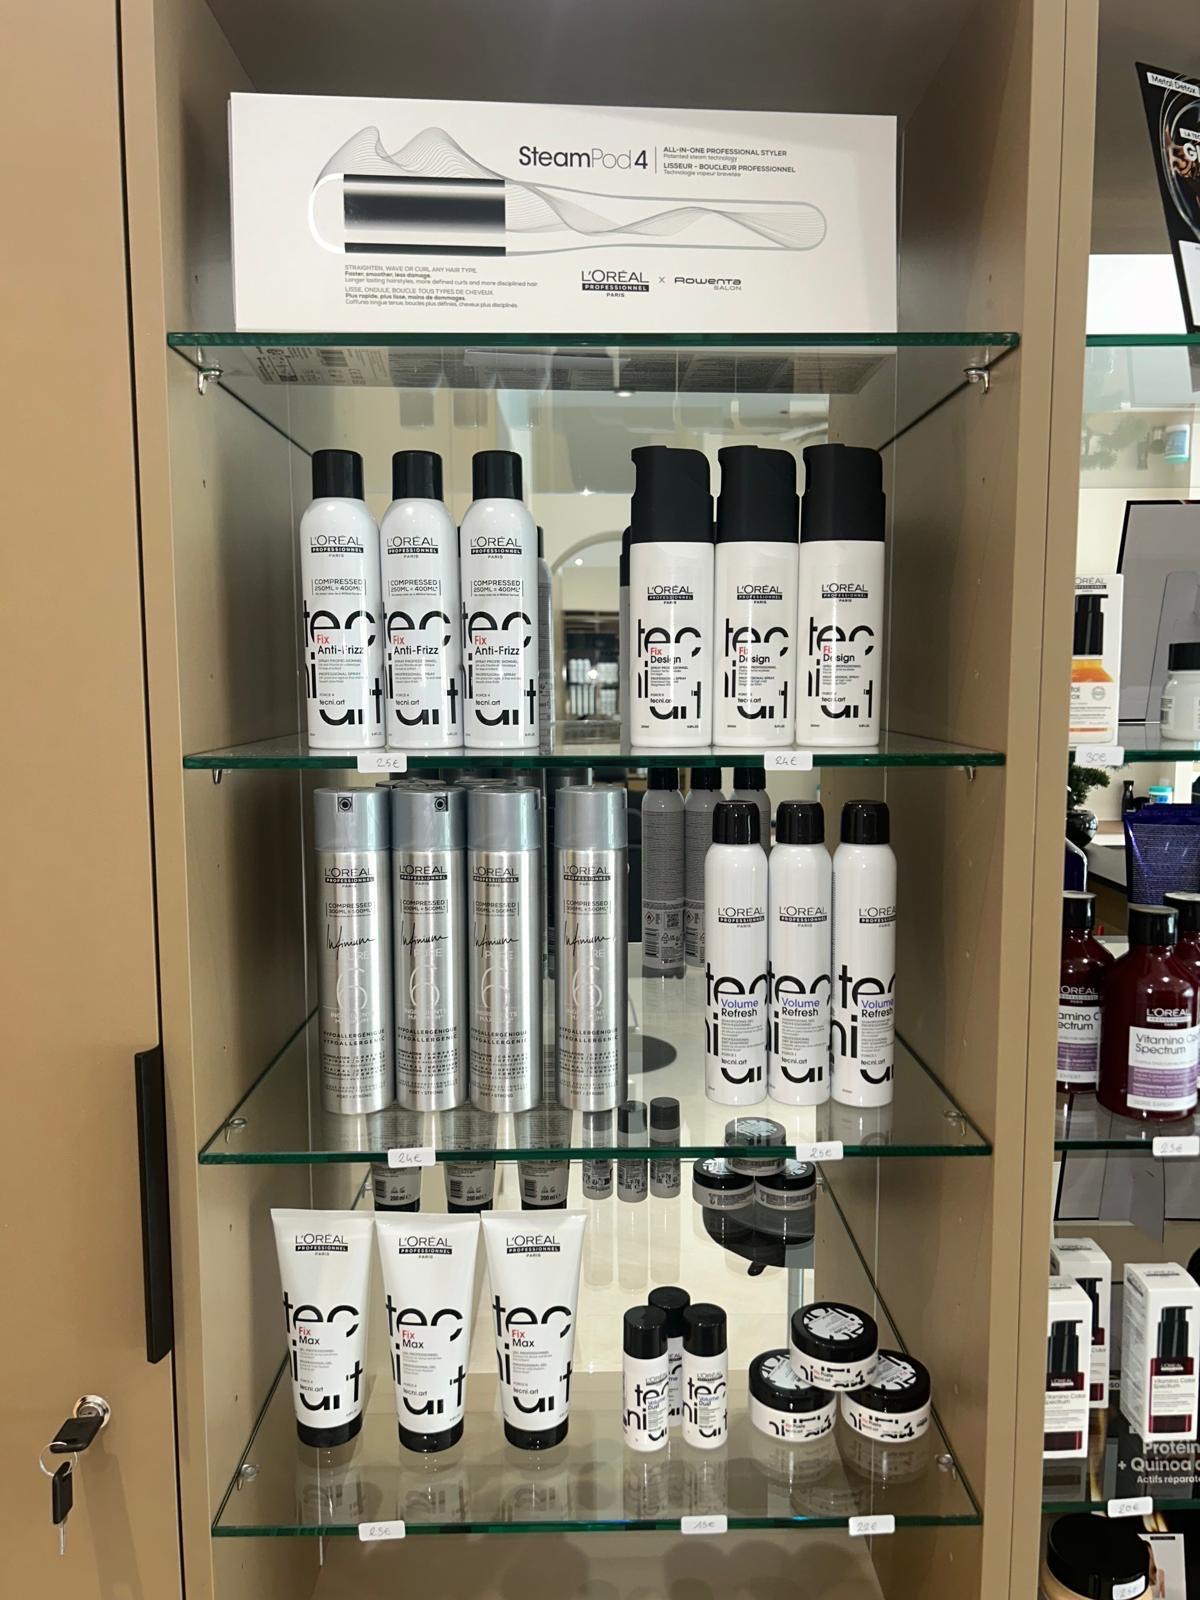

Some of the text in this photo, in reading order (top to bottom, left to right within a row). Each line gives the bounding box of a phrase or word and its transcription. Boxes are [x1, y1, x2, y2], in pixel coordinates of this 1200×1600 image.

[1152, 75, 1196, 94] Metal Detox
[706, 148, 760, 156] PROFESSIONAL
[519, 146, 648, 169] SteamPod 4
[581, 270, 742, 285] L'ORÉAL Rowenta
[310, 535, 363, 546] L'ORÉAL
[387, 536, 438, 546] L'ORÉAL
[470, 536, 522, 547] L'ORÉAL
[648, 585, 693, 594] L'ORÉAL
[737, 585, 782, 594] L'ORÉAL
[822, 583, 868, 592] L'ORÉAL
[317, 635, 329, 644] Fix
[393, 635, 405, 645] Fix
[474, 635, 487, 645] Fix
[318, 645, 364, 654] Anti-Frizz
[394, 646, 438, 655] Anti-Frizz
[475, 646, 520, 655] Anti-Frizz
[376, 758, 400, 768] 25€
[776, 756, 797, 766] 24€
[718, 906, 764, 916] L'ORÉAL
[779, 906, 827, 916] L'ORÉAL
[721, 998, 758, 1008] Volume
[782, 998, 820, 1008] Volume
[721, 1007, 757, 1018] Refresh
[782, 1007, 818, 1017] Refresh
[1146, 1008, 1190, 1017] L'ORÉAL
[1136, 1033, 1184, 1045] Vitamino
[1135, 1043, 1186, 1055] Spectrum
[398, 1153, 422, 1163] 24€
[295, 1233, 348, 1244] L'ORÉAL
[398, 1236, 452, 1247] L'ORÉAL
[506, 1235, 560, 1246] L'ORÉAL
[299, 1327, 311, 1336] Fix
[402, 1330, 415, 1339] Fix
[512, 1329, 525, 1338] Fix
[299, 1336, 320, 1345] Max
[402, 1339, 424, 1349] Max
[512, 1338, 534, 1347] Max
[513, 1388, 538, 1396] tecni.art
[1131, 1458, 1191, 1472] Quinoa
[1138, 1475, 1162, 1483] Actifs
